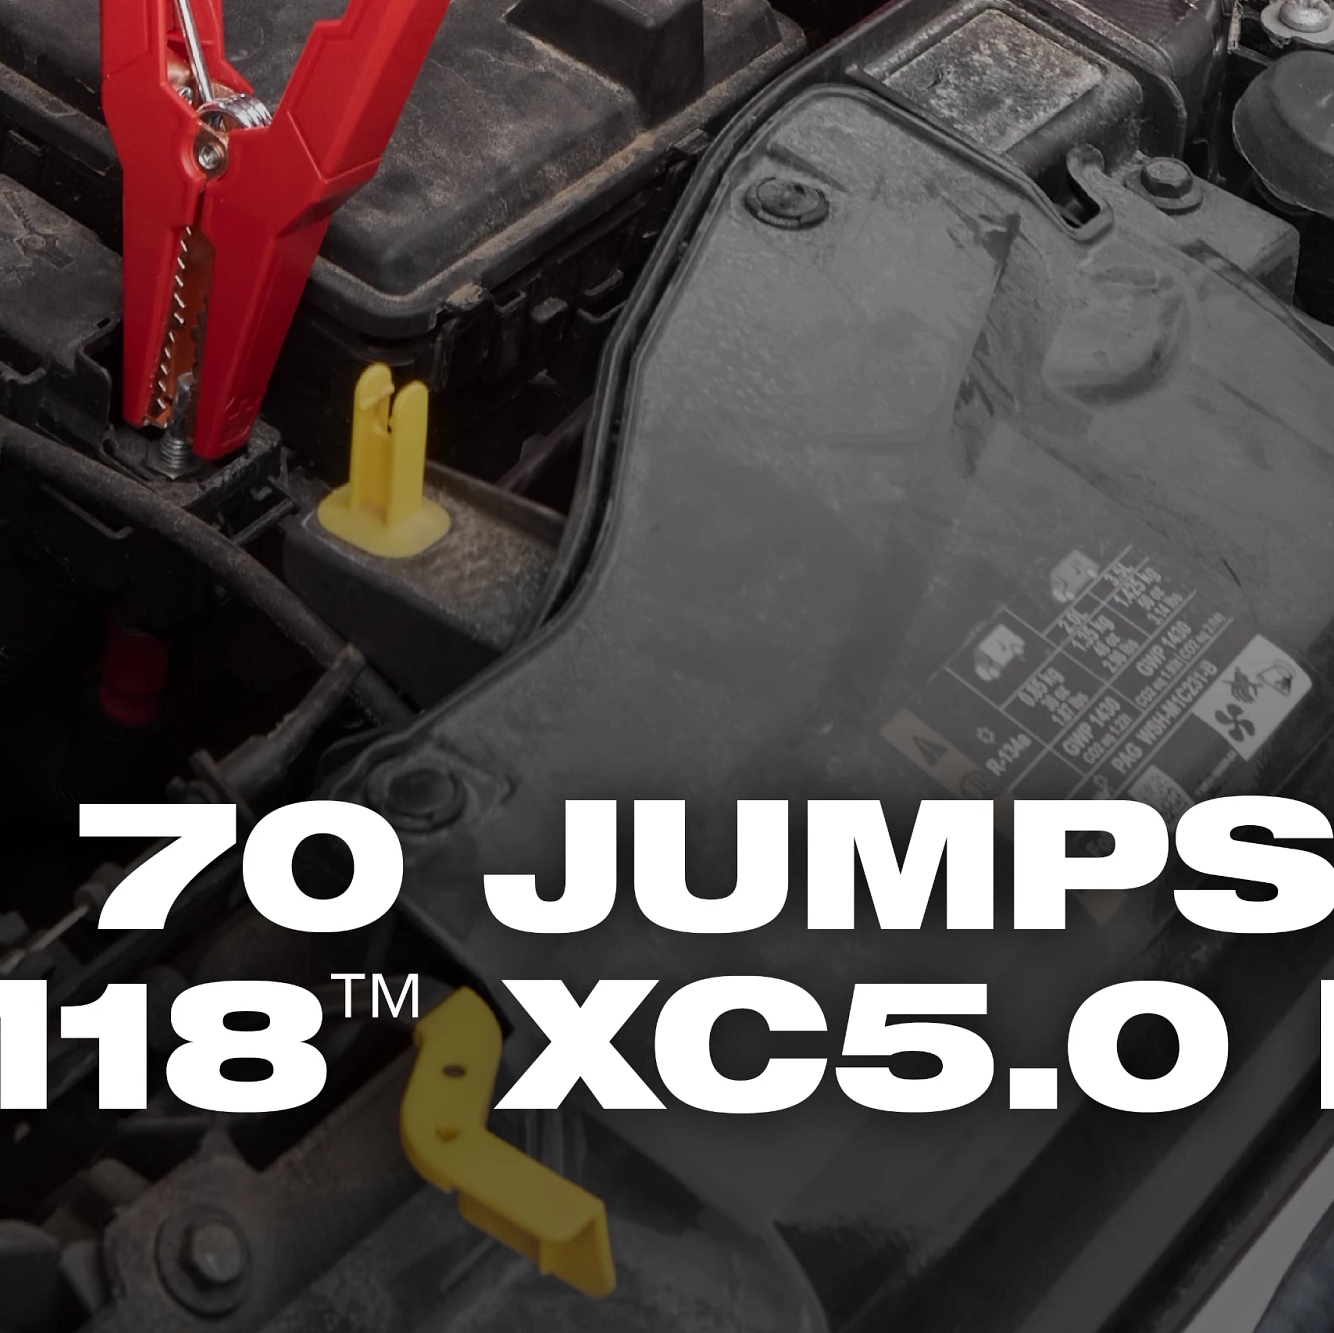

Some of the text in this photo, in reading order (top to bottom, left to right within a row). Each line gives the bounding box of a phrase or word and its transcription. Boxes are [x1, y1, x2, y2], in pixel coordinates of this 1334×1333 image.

[1133, 618, 1194, 679] GWP 1430
[1059, 694, 1123, 759] GWP 1430
[1109, 740, 1147, 776] PAG
